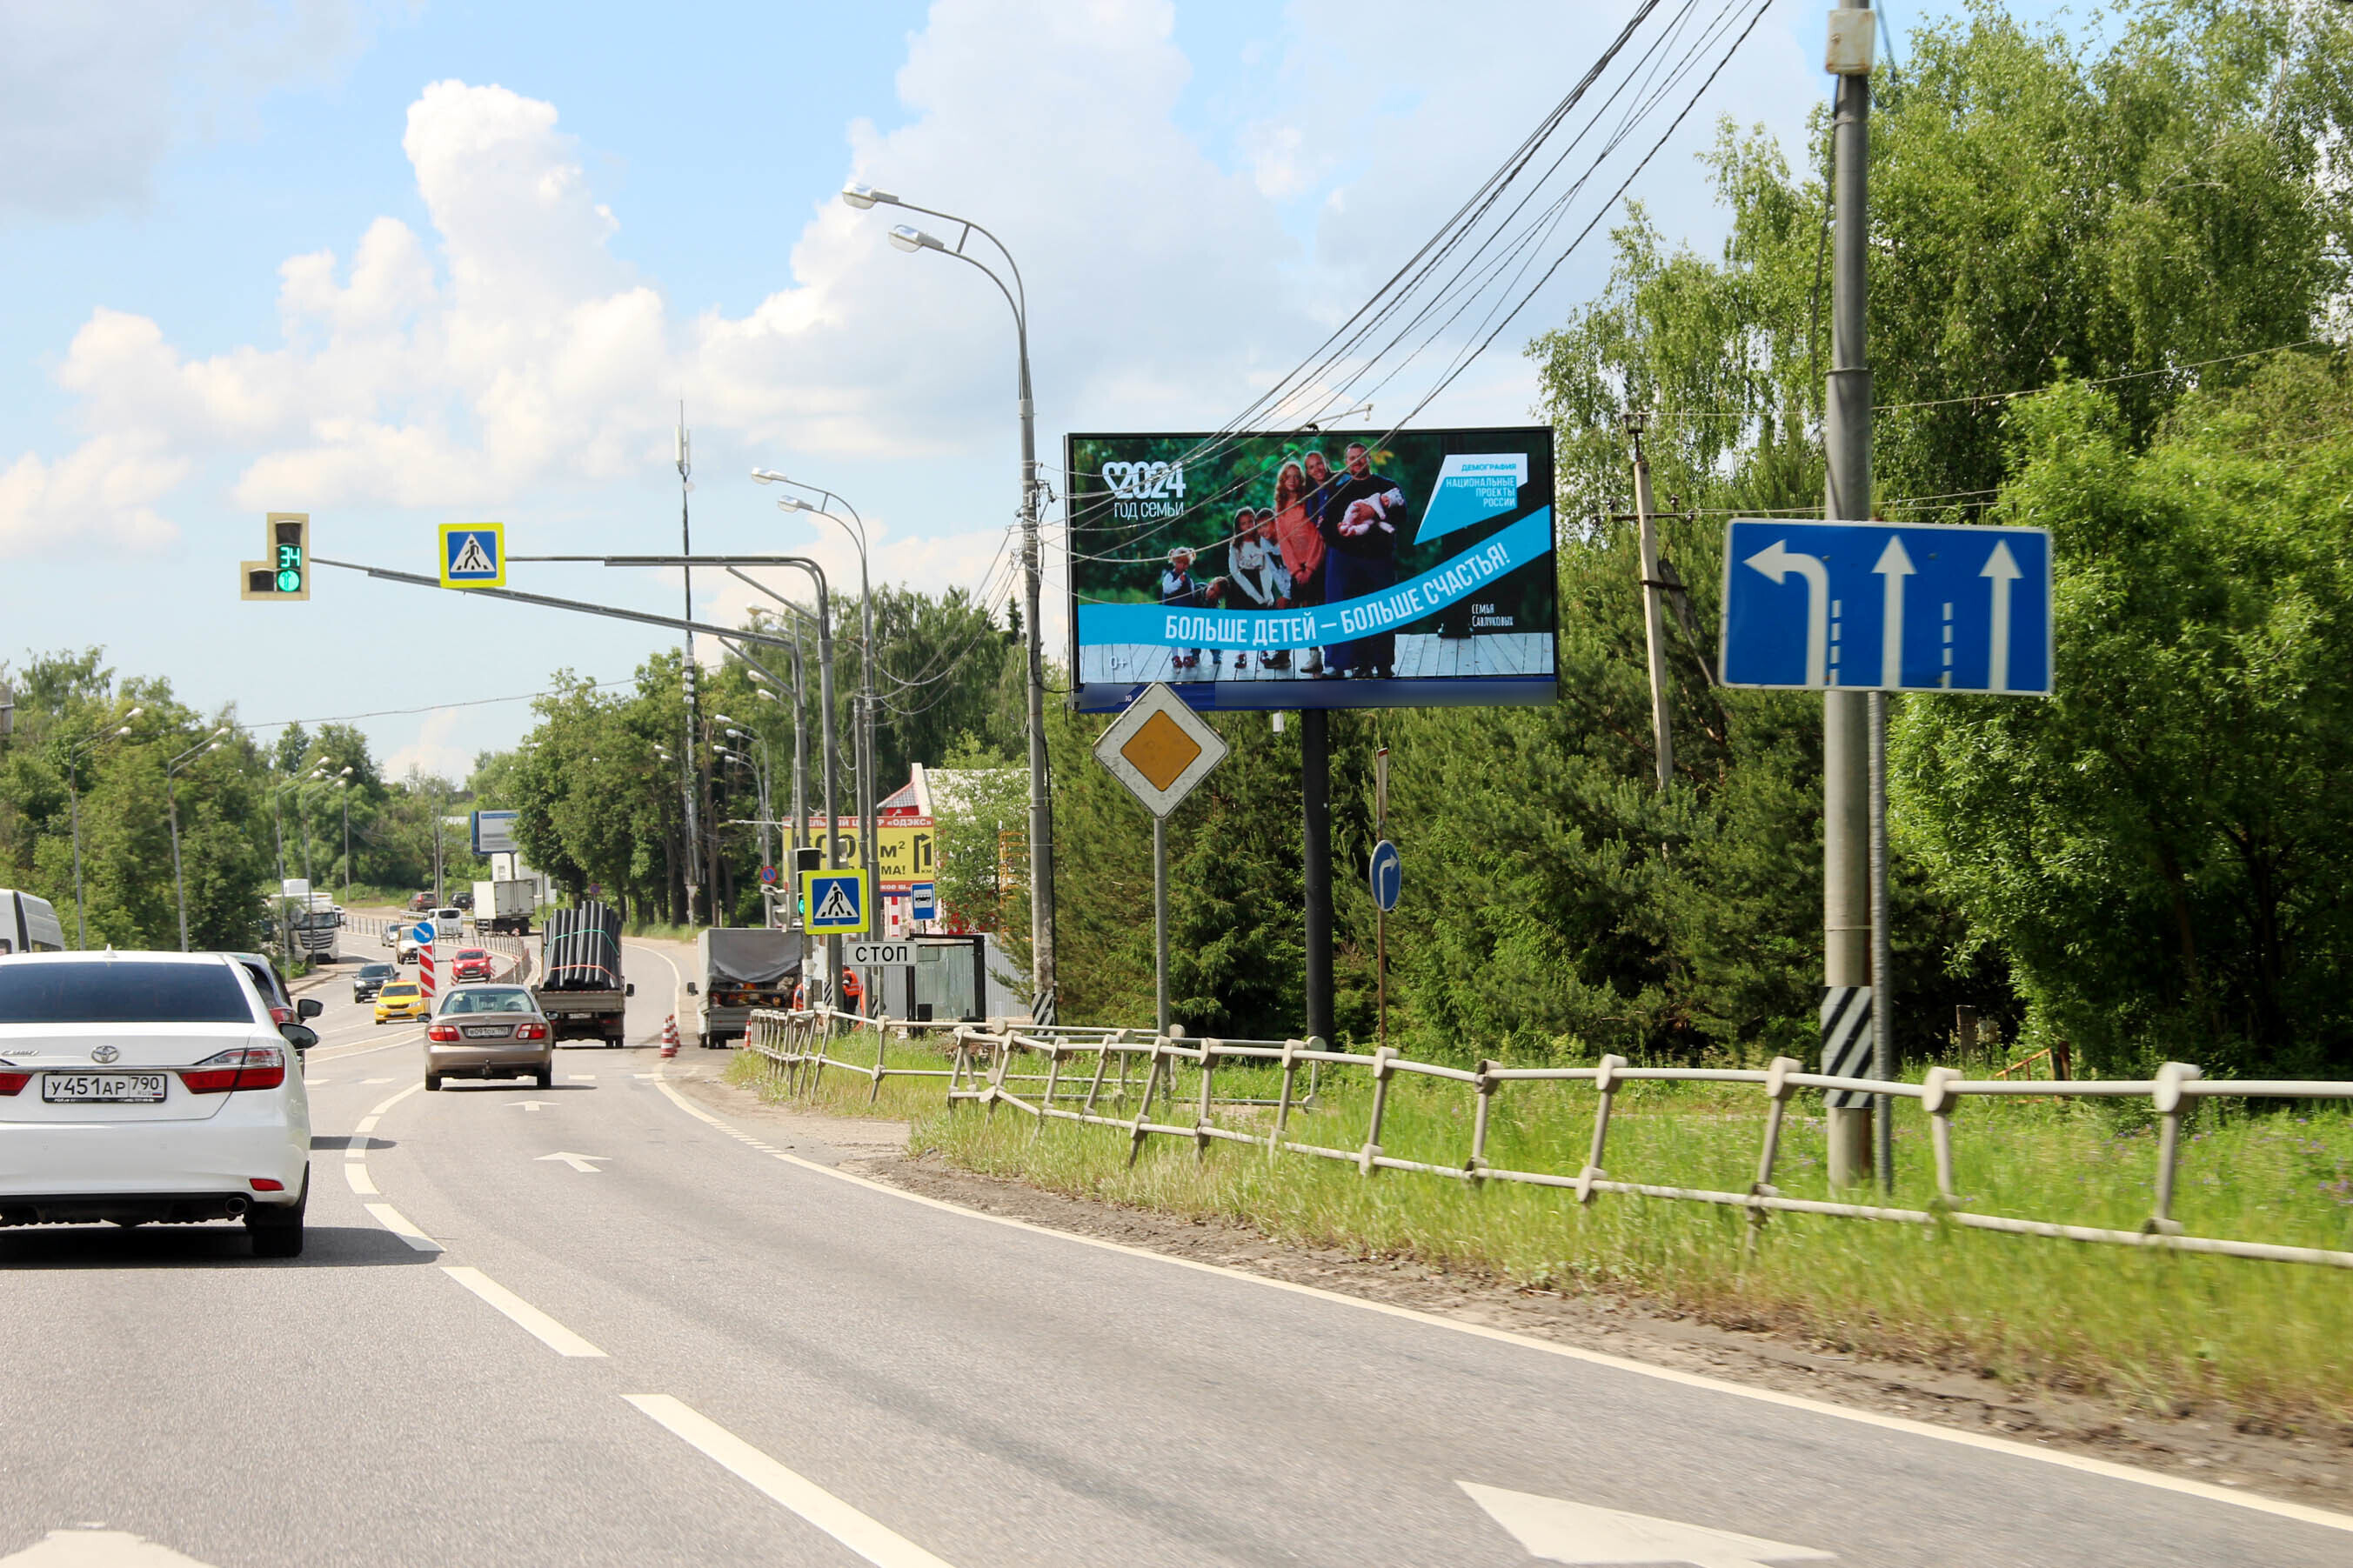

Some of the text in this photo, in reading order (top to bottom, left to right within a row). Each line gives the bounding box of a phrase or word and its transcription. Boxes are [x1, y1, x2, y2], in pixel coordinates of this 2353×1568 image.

[1461, 464, 1516, 472] ДЕМОГРАФИЯ
[1101, 461, 1187, 499] 2024
[1446, 477, 1514, 488] НАЦИОНАЛЬНЫЕ
[1475, 487, 1514, 497] ПРОЕКТЫ
[1482, 497, 1515, 508] РОССИИ
[279, 546, 301, 568] 34
[1166, 615, 1247, 644] БОЛЬШЕ
[1253, 611, 1316, 646] ДЕТЕЙ
[1340, 587, 1424, 634] БОЛЬШЕ
[1422, 542, 1511, 605] СЧАСТЬЯ!
[855, 946, 907, 962] СТОП
[51, 1077, 159, 1096] У451АР 790
